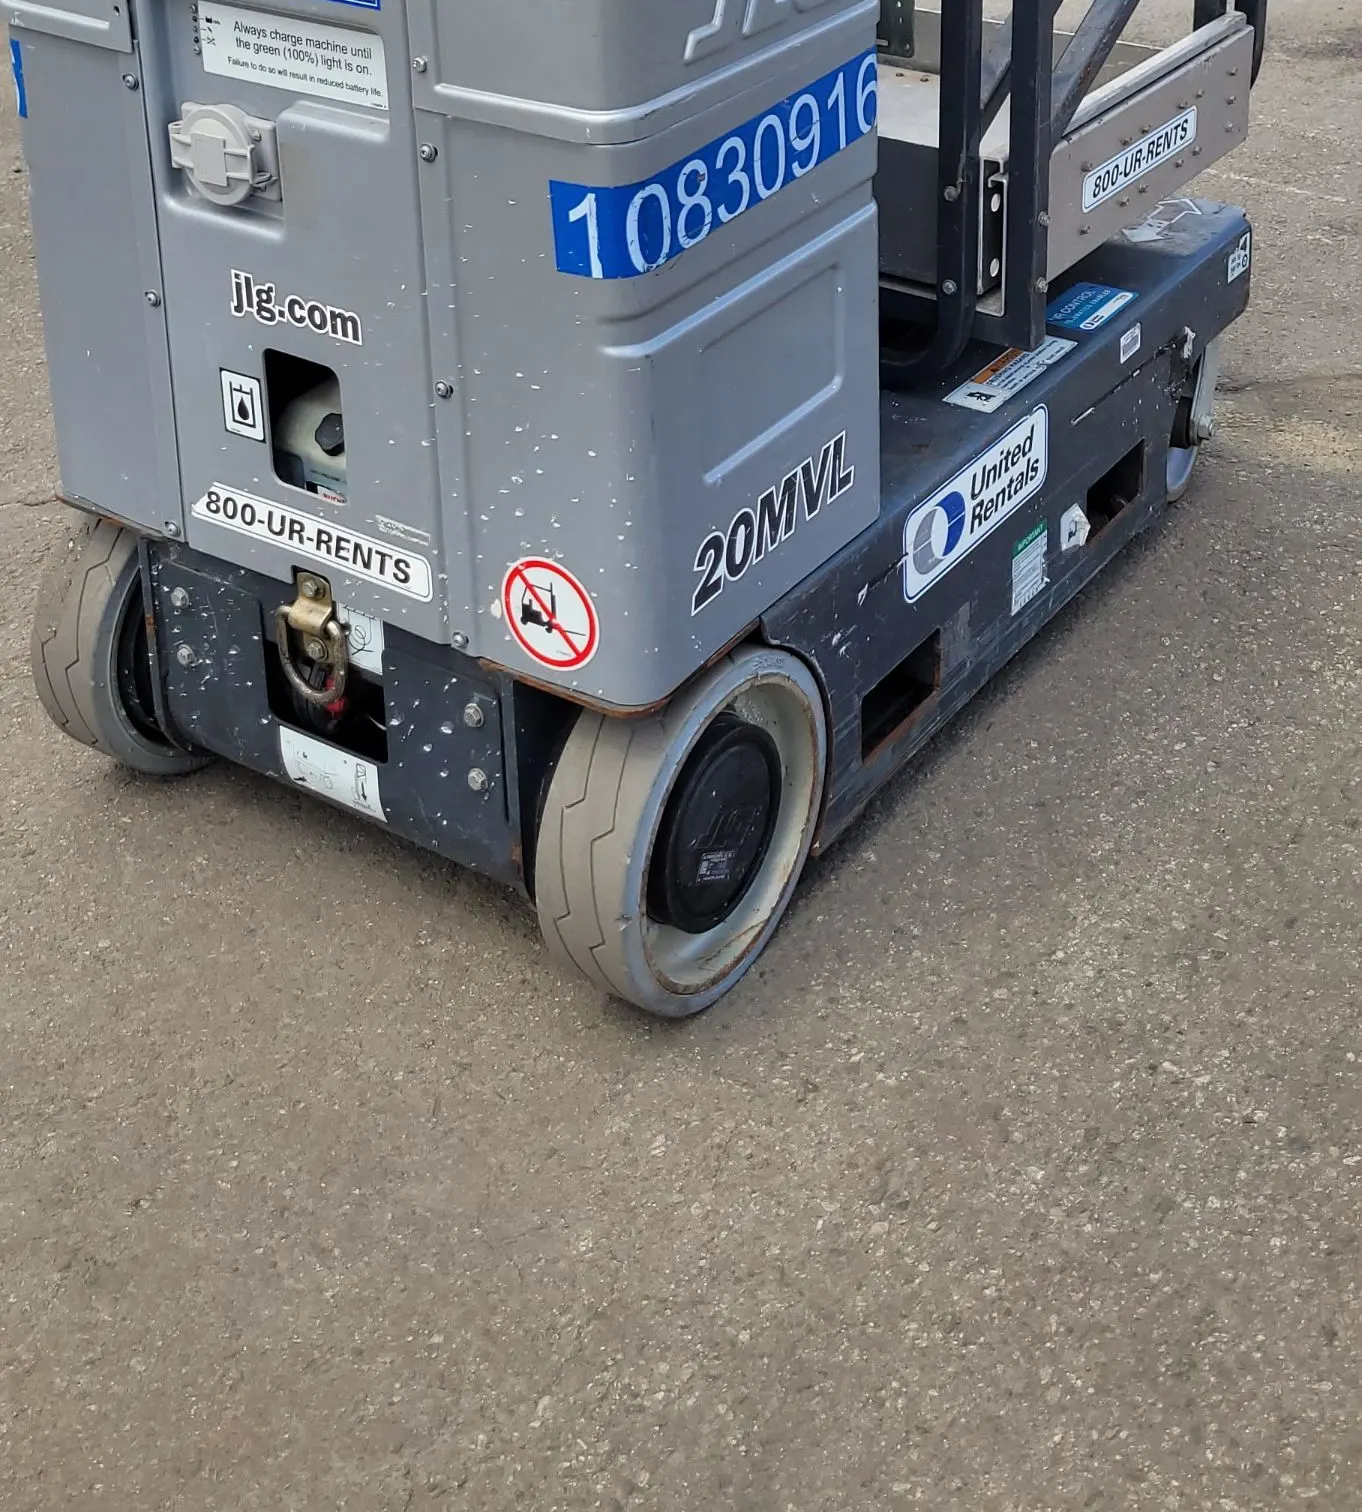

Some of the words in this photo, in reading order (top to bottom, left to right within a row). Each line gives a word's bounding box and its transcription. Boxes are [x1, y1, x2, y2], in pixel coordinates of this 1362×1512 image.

[227, 56, 250, 69] Failure
[250, 61, 257, 70] to
[258, 62, 267, 72] do
[268, 66, 277, 75] so
[277, 67, 288, 76] will
[289, 70, 308, 82] result
[308, 74, 316, 83] in
[316, 76, 345, 90] reduced
[345, 82, 369, 97] battery
[370, 88, 384, 98] life.
[233, 20, 267, 39] Always
[269, 29, 303, 47] charge
[305, 37, 348, 55] machine
[351, 46, 372, 59] until
[235, 36, 251, 50] the
[253, 42, 281, 57] green
[283, 46, 319, 67] (100%)
[321, 54, 342, 70] light
[344, 60, 353, 72] is
[355, 64, 373, 77] on.
[568, 52, 878, 279] 10830916
[1092, 118, 1190, 199] 800-UR-RENTS
[232, 270, 362, 344] jlg.com
[969, 425, 1036, 501] United
[969, 457, 1041, 536] Rentals
[205, 490, 412, 584] 800-UR-RENTS
[691, 430, 855, 617] 20MVL
